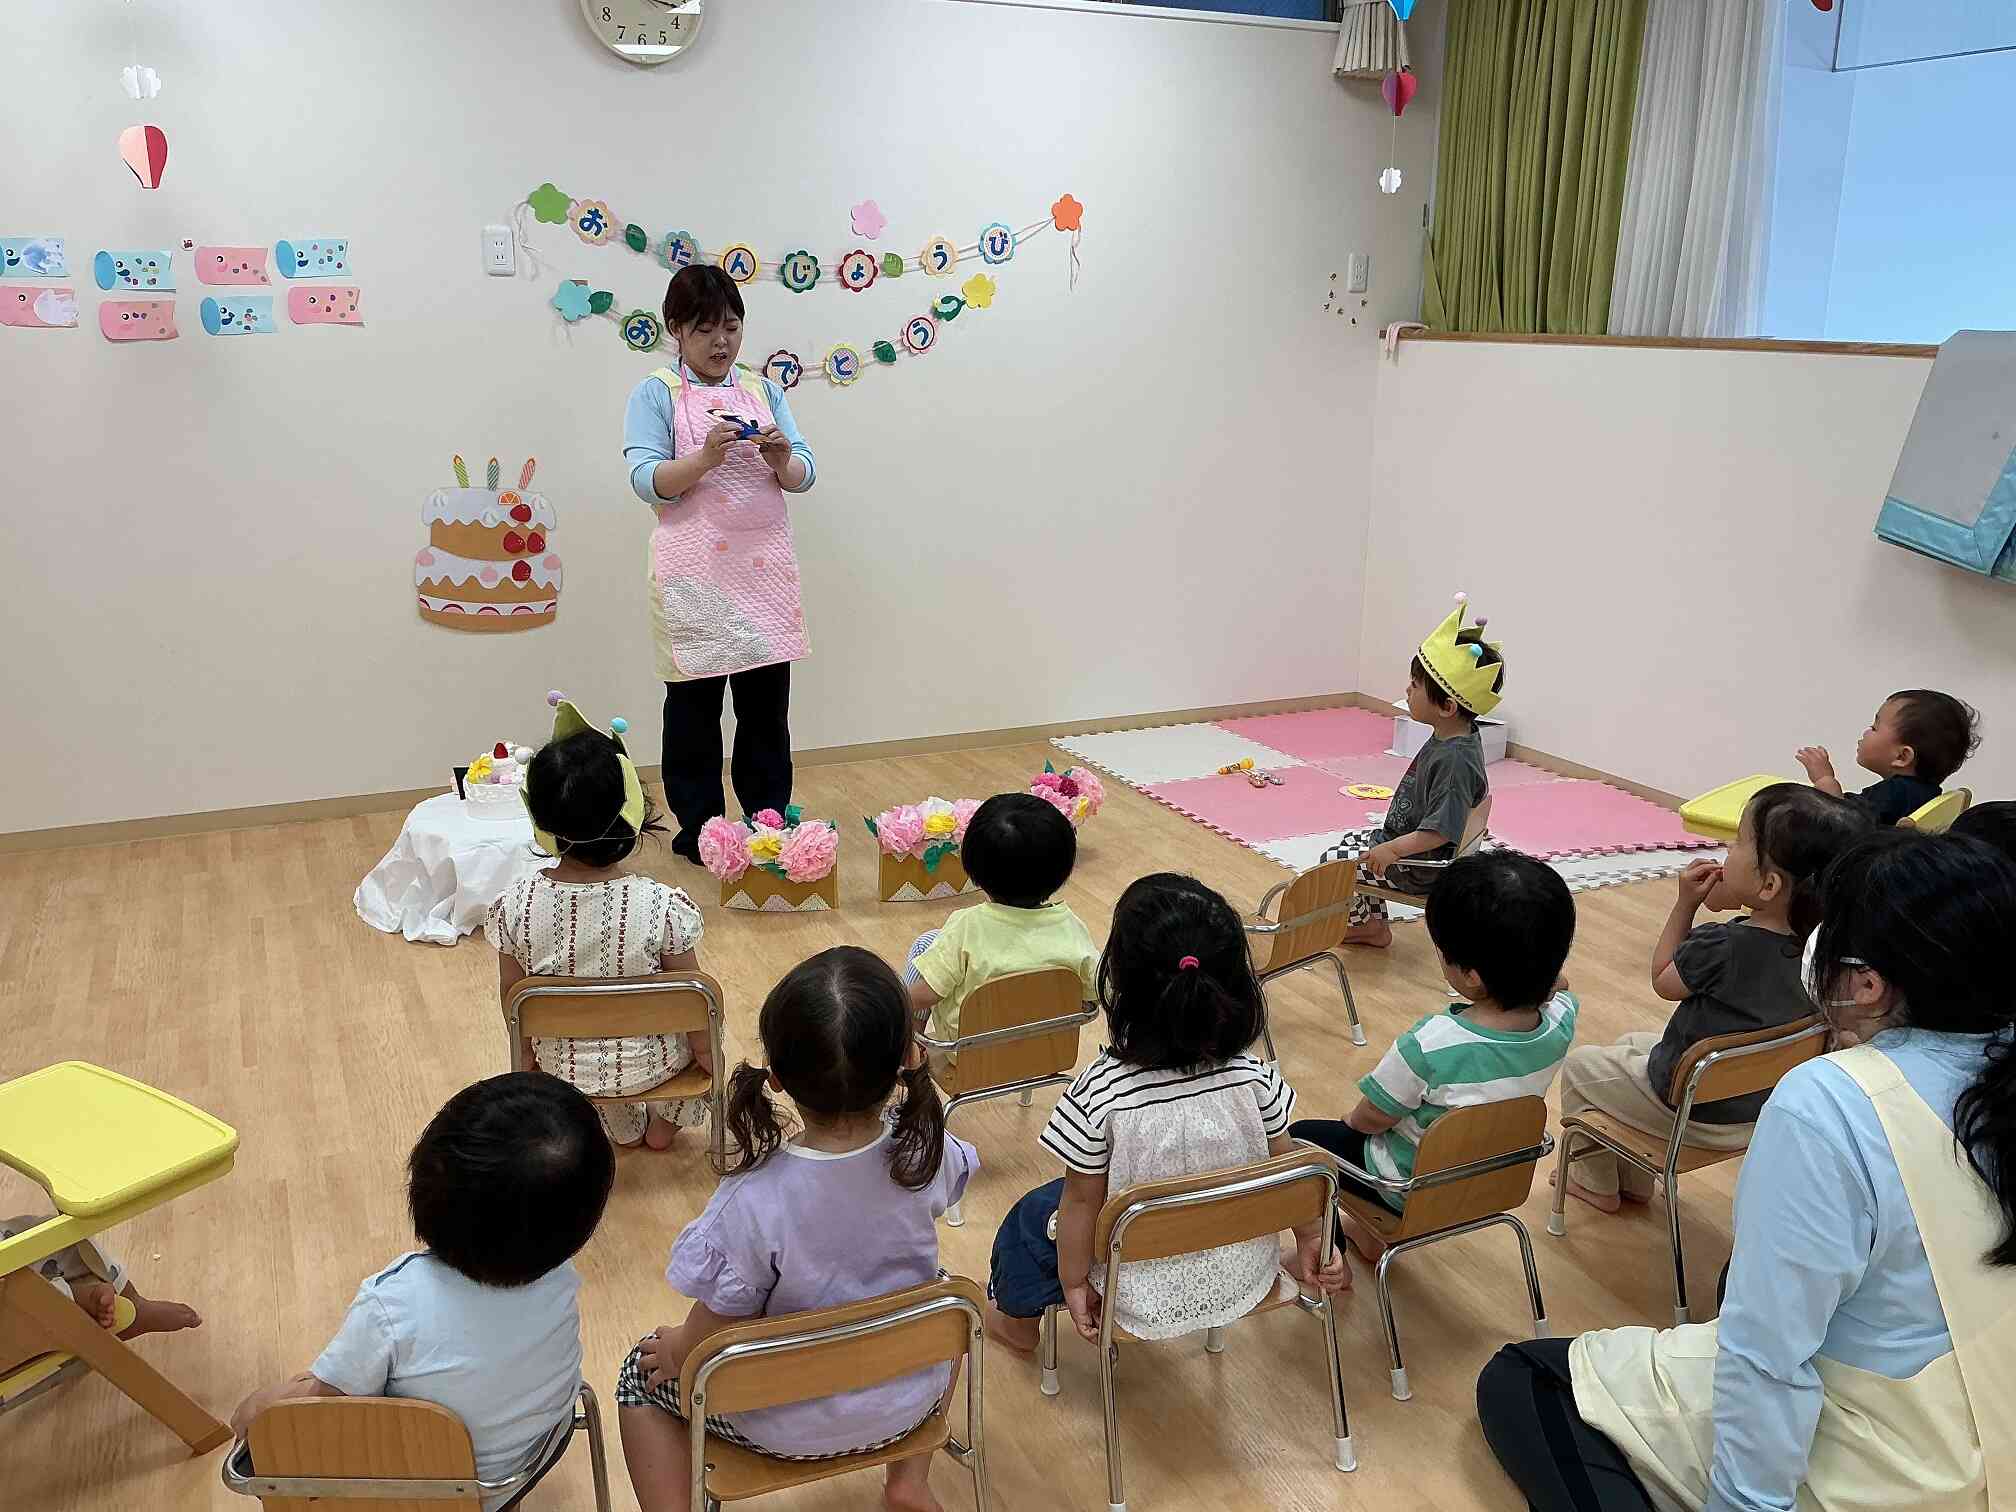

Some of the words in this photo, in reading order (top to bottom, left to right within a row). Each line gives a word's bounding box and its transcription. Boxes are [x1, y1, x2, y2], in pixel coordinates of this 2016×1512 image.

[602, 6, 612, 22] 8
[671, 15, 681, 30] 4
[617, 25, 626, 40] 7
[658, 31, 667, 45] 5
